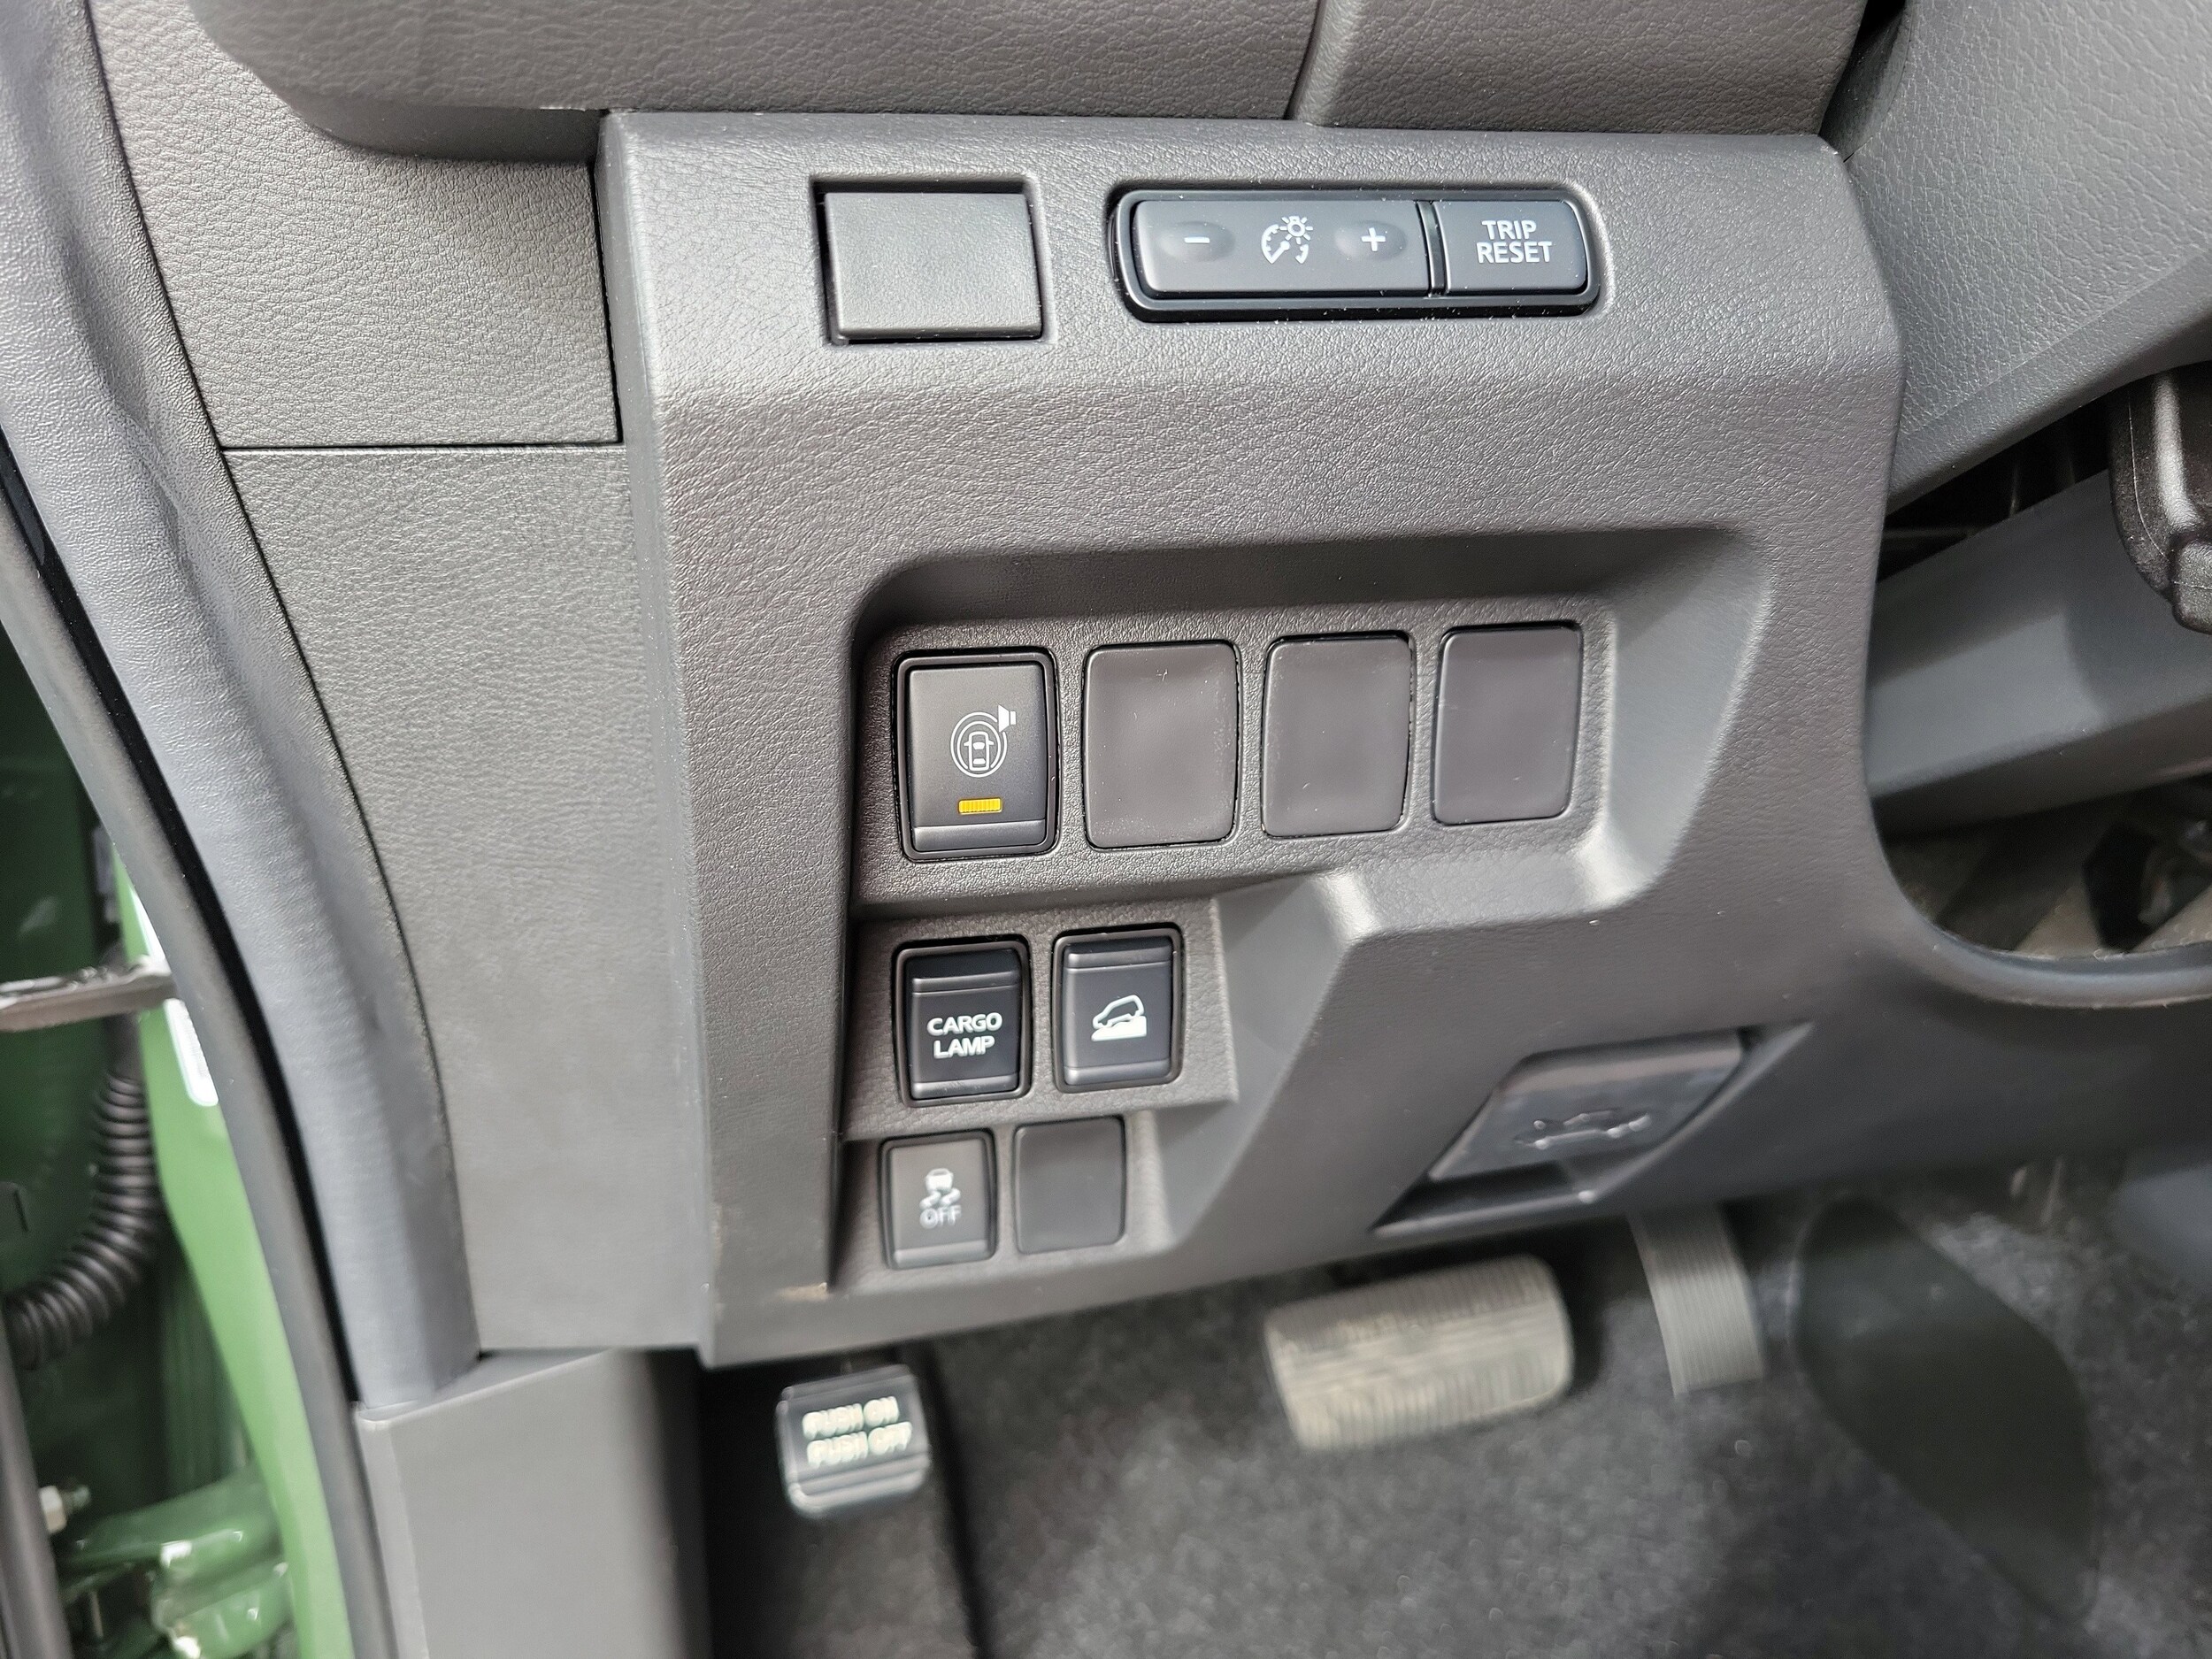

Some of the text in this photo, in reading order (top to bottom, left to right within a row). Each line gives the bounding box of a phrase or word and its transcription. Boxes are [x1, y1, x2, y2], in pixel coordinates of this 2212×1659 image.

[1481, 219, 1537, 240] TRIP
[1476, 242, 1553, 264] RESET
[926, 1012, 1002, 1036] CARGO
[933, 1035, 995, 1059] LAMP
[919, 1205, 962, 1229] OFF
